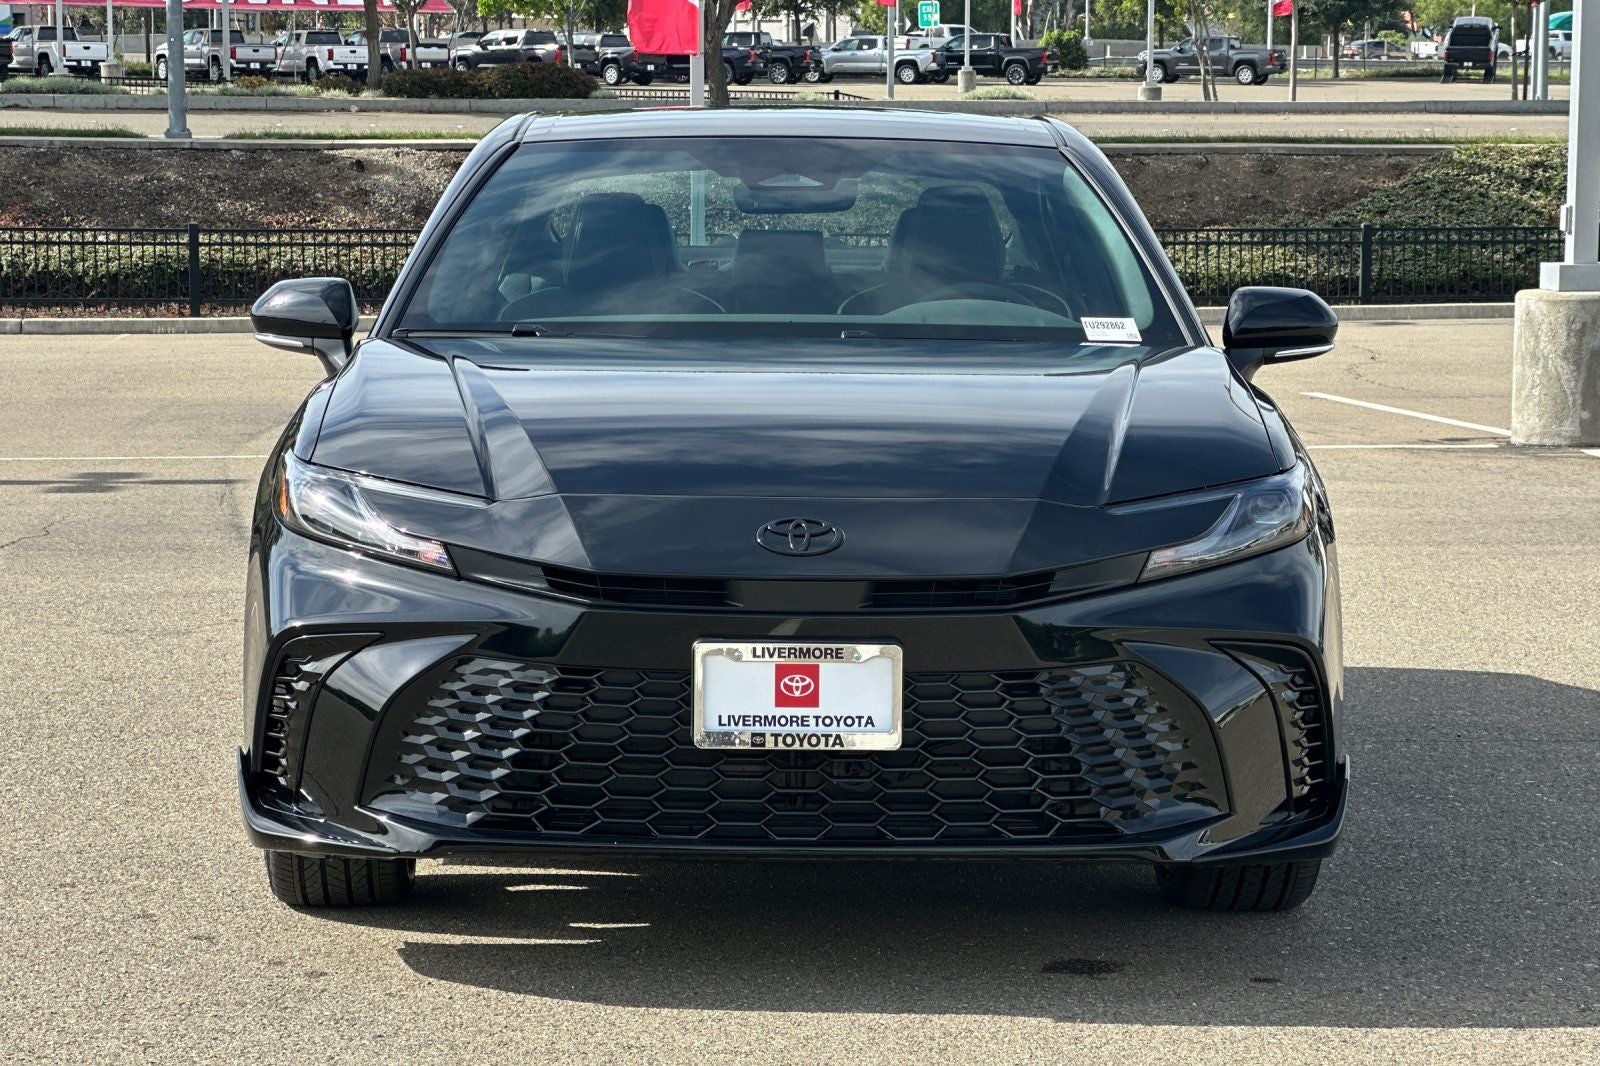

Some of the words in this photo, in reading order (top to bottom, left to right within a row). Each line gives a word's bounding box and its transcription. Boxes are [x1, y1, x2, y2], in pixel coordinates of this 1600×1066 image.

[1084, 321, 1126, 330] TU292862
[752, 646, 844, 660] LIVERMORE
[718, 714, 810, 728] LIVERMORE
[813, 715, 875, 728] TOYOTA
[771, 732, 845, 748] TOYOTA
